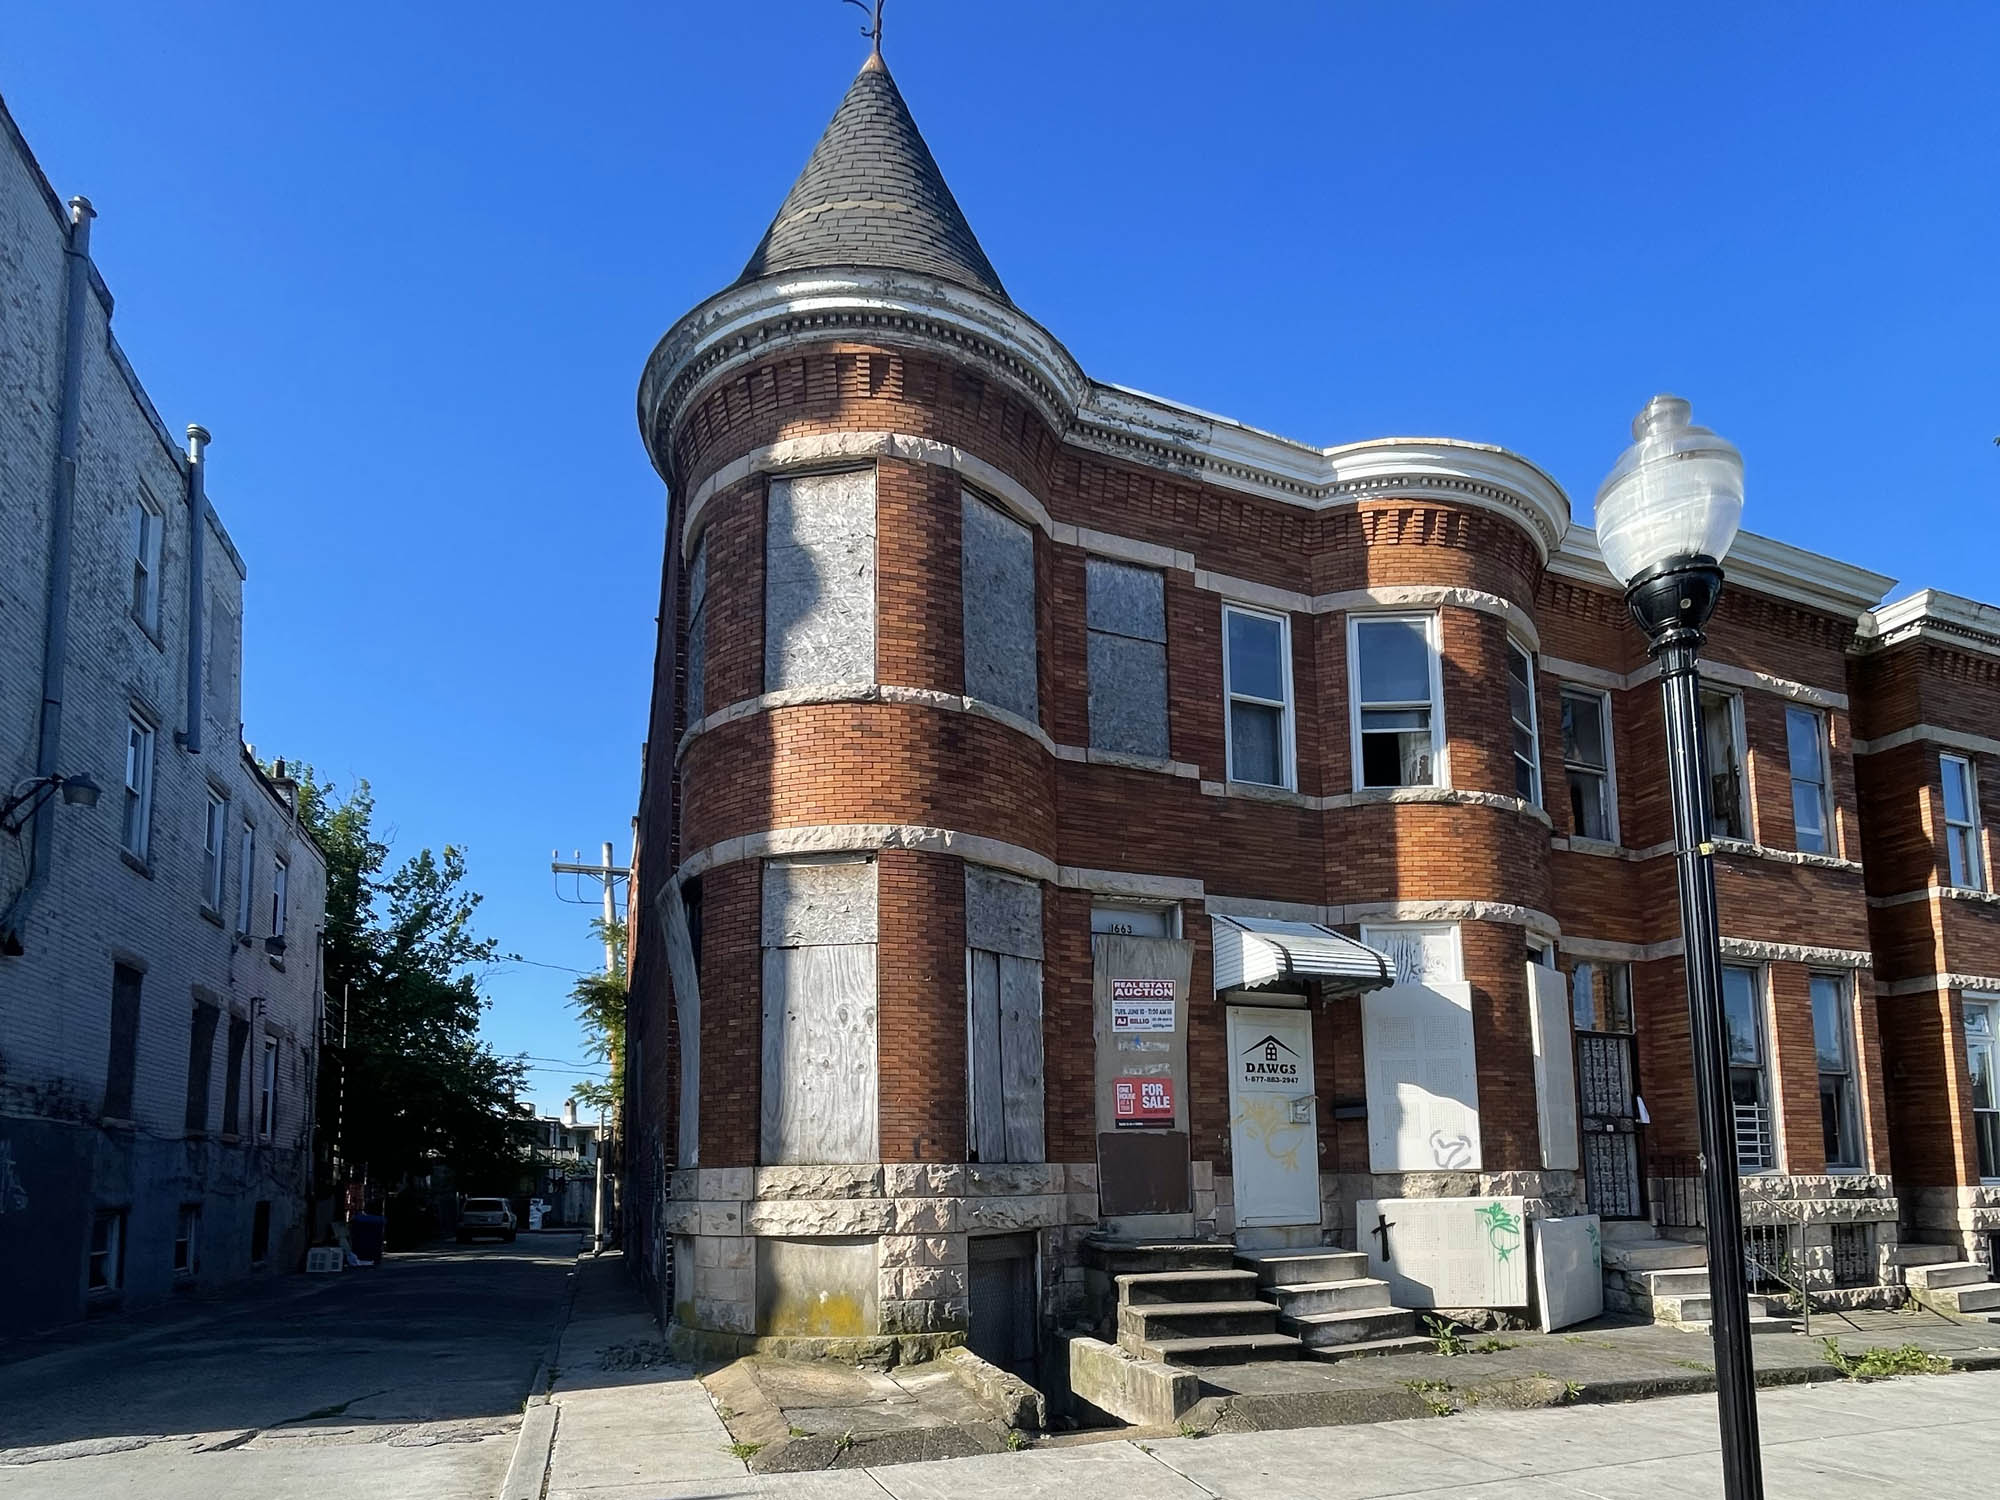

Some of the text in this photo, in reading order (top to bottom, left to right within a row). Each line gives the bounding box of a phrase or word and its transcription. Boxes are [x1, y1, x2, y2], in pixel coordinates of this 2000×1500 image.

[1111, 923, 1132, 934] 1663
[1114, 988, 1173, 996] AUCTION
[1141, 1083, 1164, 1096] FOR
[1142, 1096, 1170, 1109] SALE
